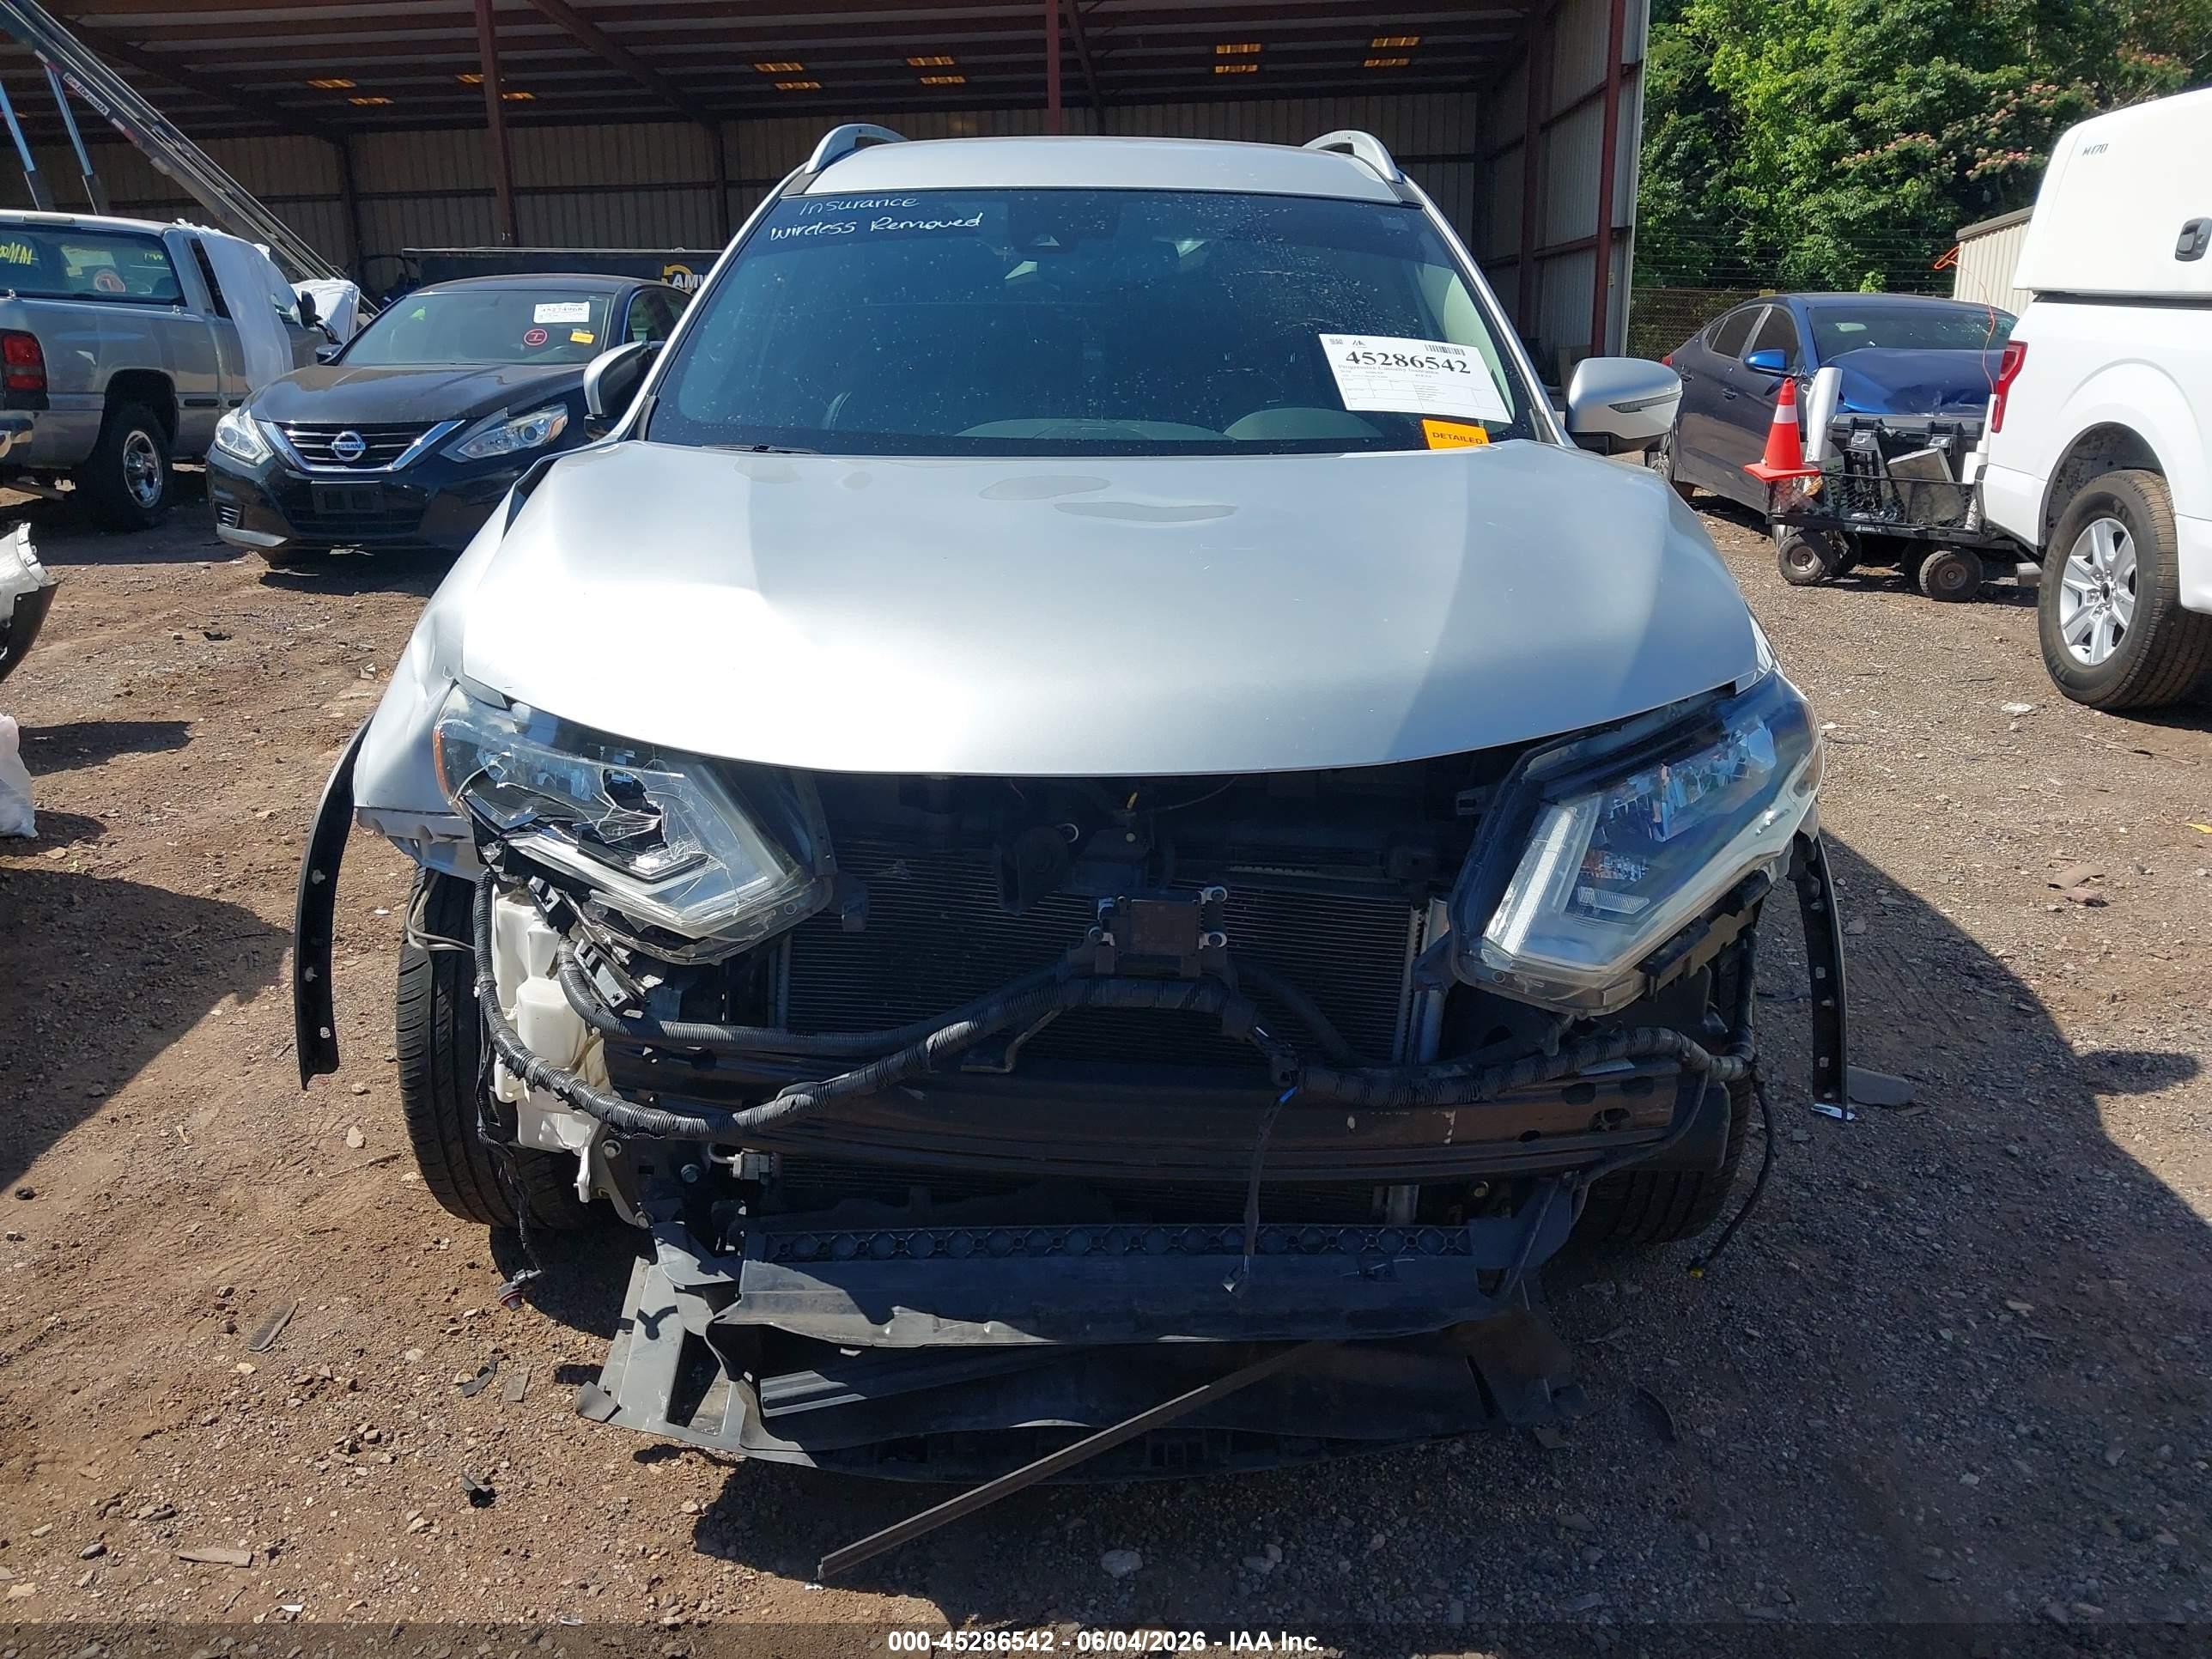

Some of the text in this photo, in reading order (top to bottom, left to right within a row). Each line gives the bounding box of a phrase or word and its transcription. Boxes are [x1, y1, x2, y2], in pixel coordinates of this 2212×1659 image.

[799, 197, 919, 216] Insurance
[869, 212, 984, 232] Removed
[1346, 350, 1471, 374] 45286542
[1432, 432, 1483, 445] DETAILED
